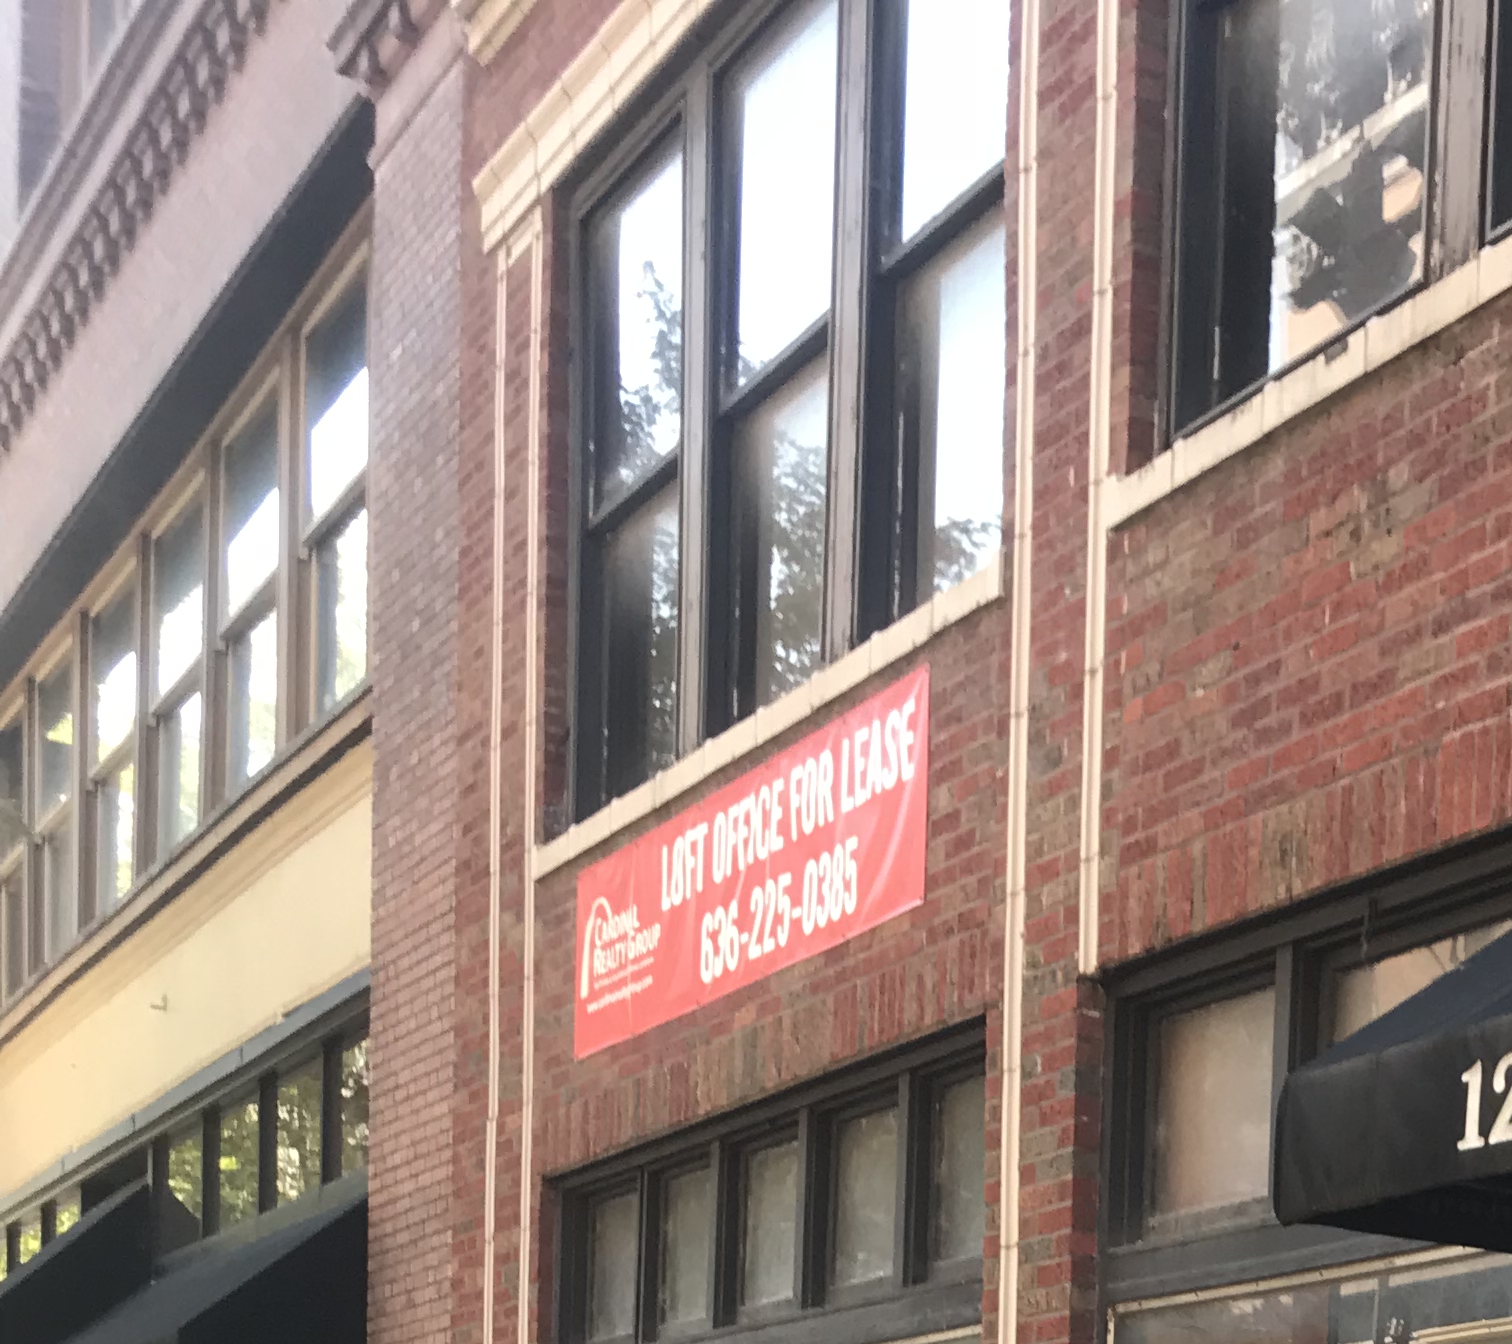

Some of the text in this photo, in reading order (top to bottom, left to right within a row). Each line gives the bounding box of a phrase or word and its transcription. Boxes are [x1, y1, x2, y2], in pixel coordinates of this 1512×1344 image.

[661, 699, 915, 912] LOFT OFFICE FOR LEASE
[700, 835, 859, 984] 636-225-0385
